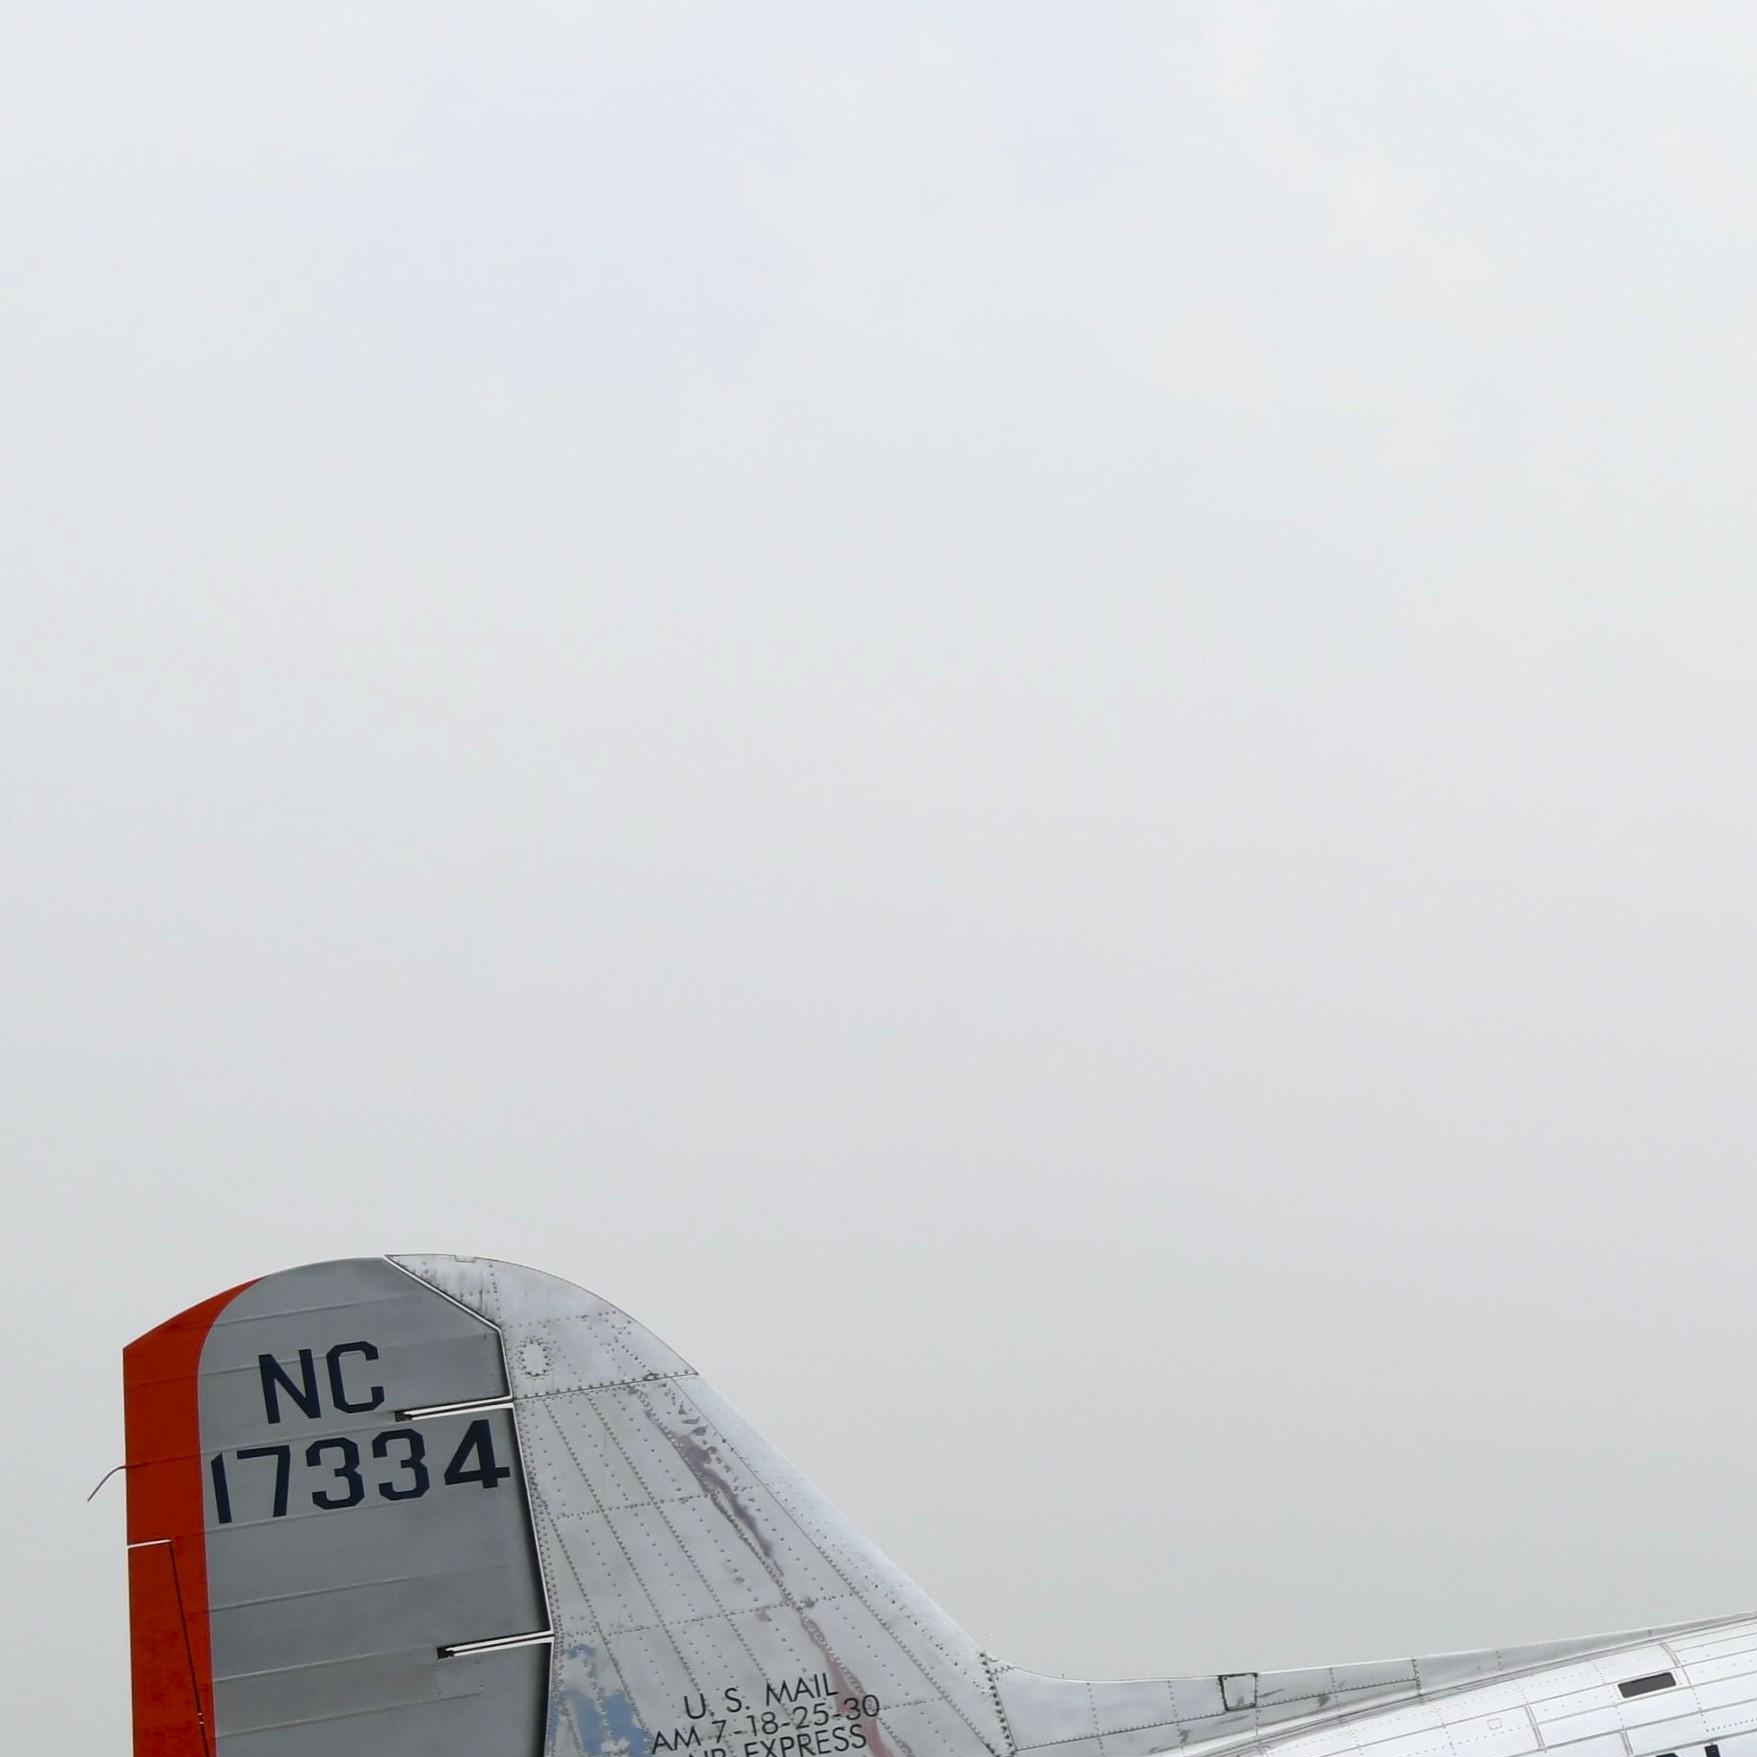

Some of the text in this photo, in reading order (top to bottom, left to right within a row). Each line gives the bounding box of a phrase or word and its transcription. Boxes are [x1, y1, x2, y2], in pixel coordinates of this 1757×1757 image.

[258, 1341, 386, 1425] NC
[210, 1418, 512, 1525] 17334
[765, 1672, 838, 1706] MAIL
[651, 1725, 702, 1755] AM
